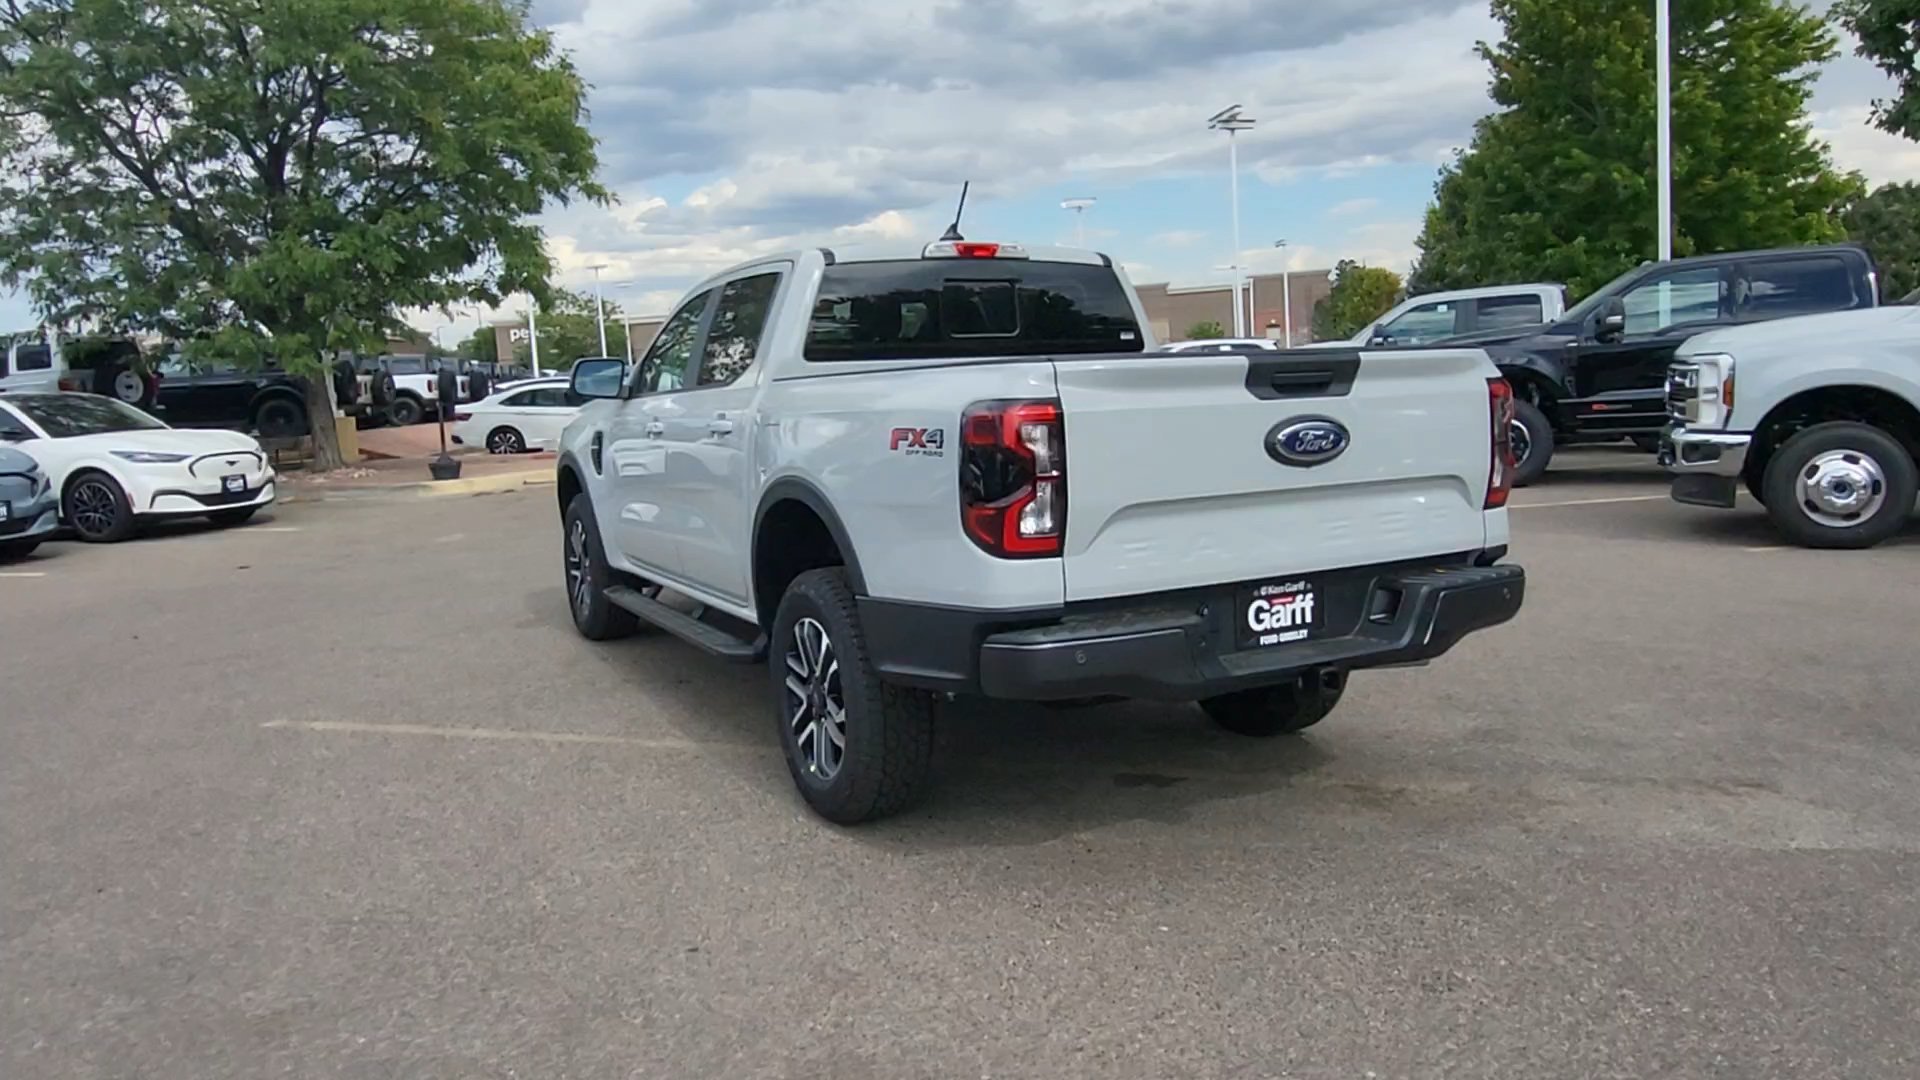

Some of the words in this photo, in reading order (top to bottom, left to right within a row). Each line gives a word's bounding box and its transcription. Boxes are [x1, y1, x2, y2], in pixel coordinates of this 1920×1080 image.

[510, 328, 531, 342] pe
[890, 428, 944, 450] FX4
[1295, 429, 1335, 451] Ford
[1247, 592, 1314, 632] Garff
